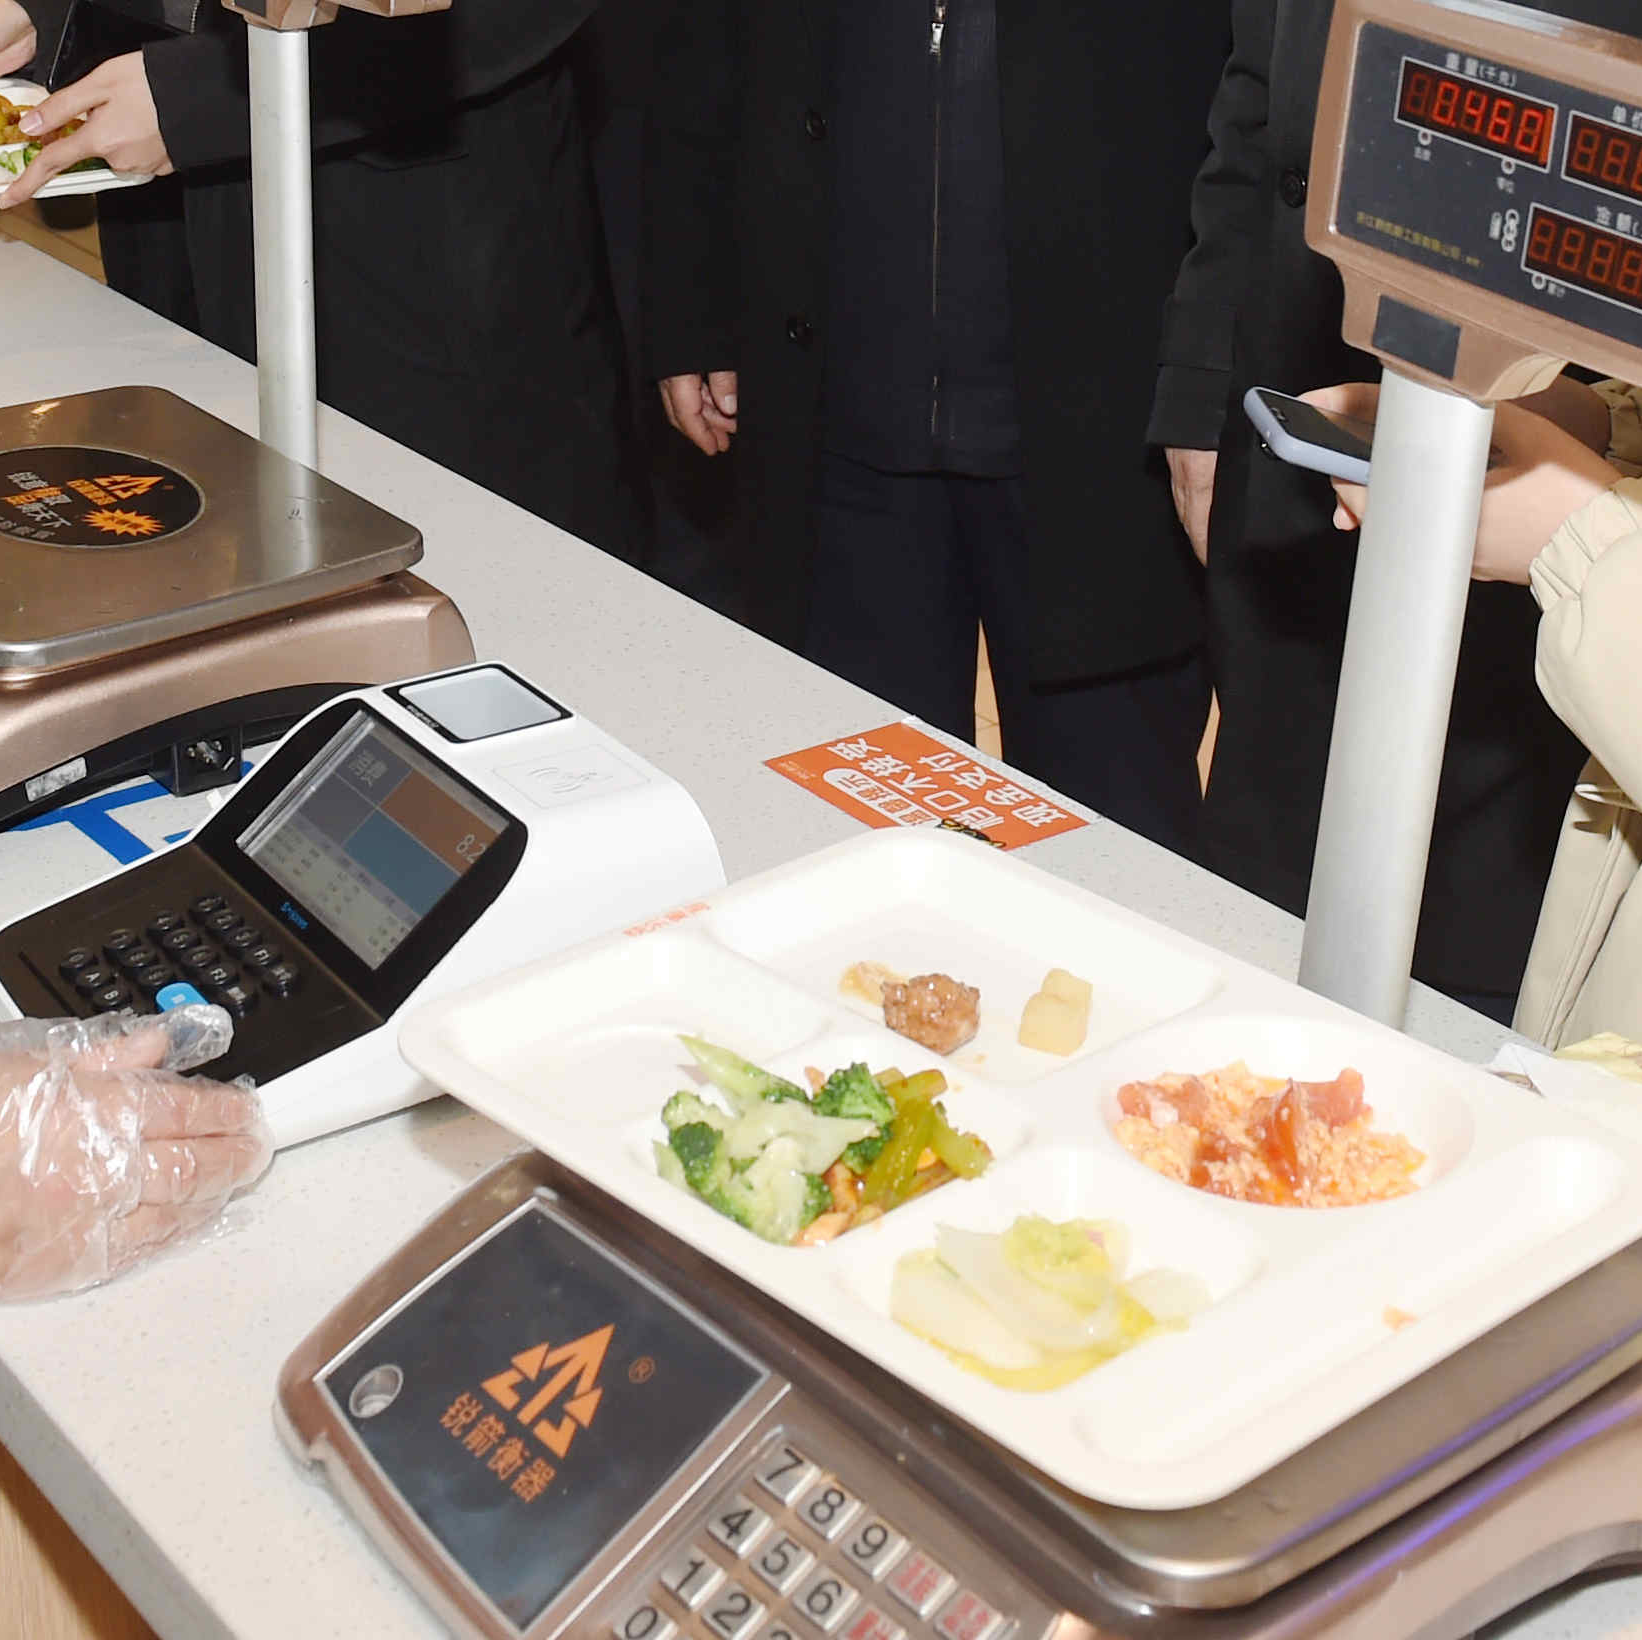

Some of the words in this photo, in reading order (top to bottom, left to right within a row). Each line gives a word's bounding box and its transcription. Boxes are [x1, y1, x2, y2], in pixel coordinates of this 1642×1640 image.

[917, 751, 1069, 827] 现金支付
[439, 1391, 557, 1504] 锐箭衡器
[765, 1447, 805, 1483] 7
[808, 1489, 846, 1526] 8
[851, 1525, 889, 1560] 9
[675, 1559, 705, 1593] 1
[711, 1592, 752, 1632] 2
[721, 1506, 754, 1541] 4
[761, 1538, 803, 1576] 5
[806, 1579, 843, 1616] 6
[624, 1605, 659, 1640] 0
